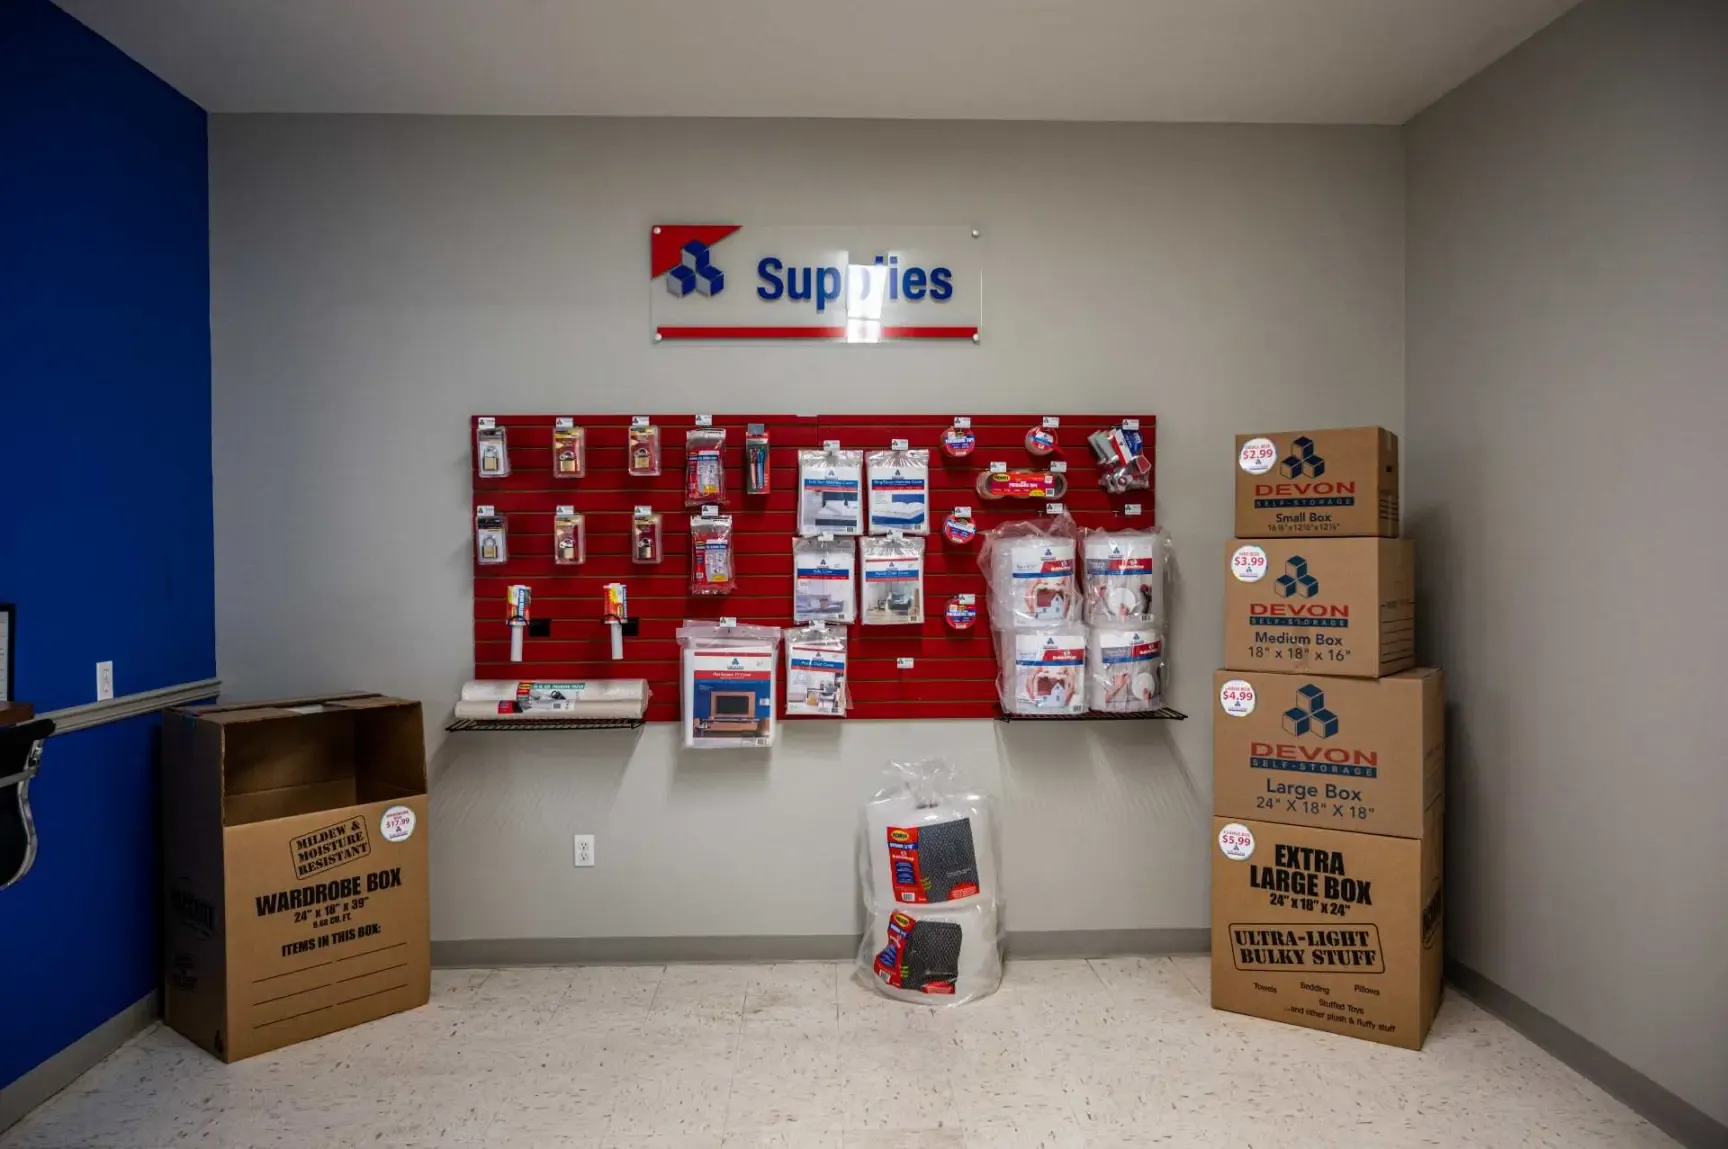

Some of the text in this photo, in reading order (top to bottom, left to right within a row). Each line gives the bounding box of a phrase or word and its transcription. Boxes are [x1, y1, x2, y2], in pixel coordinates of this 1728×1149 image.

[757, 255, 954, 314] Supies
[1243, 448, 1274, 460] $2.99
[1254, 481, 1356, 497] DEVON
[1256, 499, 1352, 507] SELF-STORAGE
[1275, 512, 1333, 523] Small Box
[1234, 556, 1265, 567] $3.99
[1249, 603, 1350, 617] DEVON
[1251, 617, 1346, 627] SELF-STORAGE
[1255, 631, 1344, 646] Medium Box
[1248, 646, 1351, 662] 18" x 18" x 16"
[1223, 690, 1254, 701] $4.99
[1250, 741, 1378, 766] DEVON
[1252, 758, 1373, 777] SELF-STORAGE
[1266, 778, 1362, 802] Large Box
[1256, 796, 1375, 820] 24" X 18" X 18"
[386, 816, 410, 829] $17.99
[296, 820, 361, 851] MILDEW &
[1222, 834, 1251, 847] $5.99
[298, 832, 365, 862] MOISTURE
[298, 842, 368, 876] RESISTANT
[1274, 843, 1345, 876] EXTRA
[255, 876, 362, 917] WARDROBE
[366, 867, 402, 893] BOX
[1250, 865, 1373, 906] LARGE BOX
[294, 909, 313, 924] 24"
[325, 903, 341, 917] 18"
[351, 896, 370, 911] 39"
[1269, 893, 1290, 907] 24"
[1301, 897, 1320, 912] 18"
[1330, 902, 1351, 917] 24"
[281, 922, 382, 957] ITEMS IN THIS BOX:
[1233, 929, 1370, 948] ULTRA-LIGHT
[1240, 948, 1376, 967] BULKY STUFF
[1253, 981, 1381, 997] Towels Bedding Pillows
[1318, 998, 1365, 1016] Stuffed Toys
[1305, 1009, 1325, 1019] other
[1326, 1013, 1347, 1025] plush
[1356, 1018, 1376, 1031] fluffy
[1378, 1023, 1396, 1034] stuff
